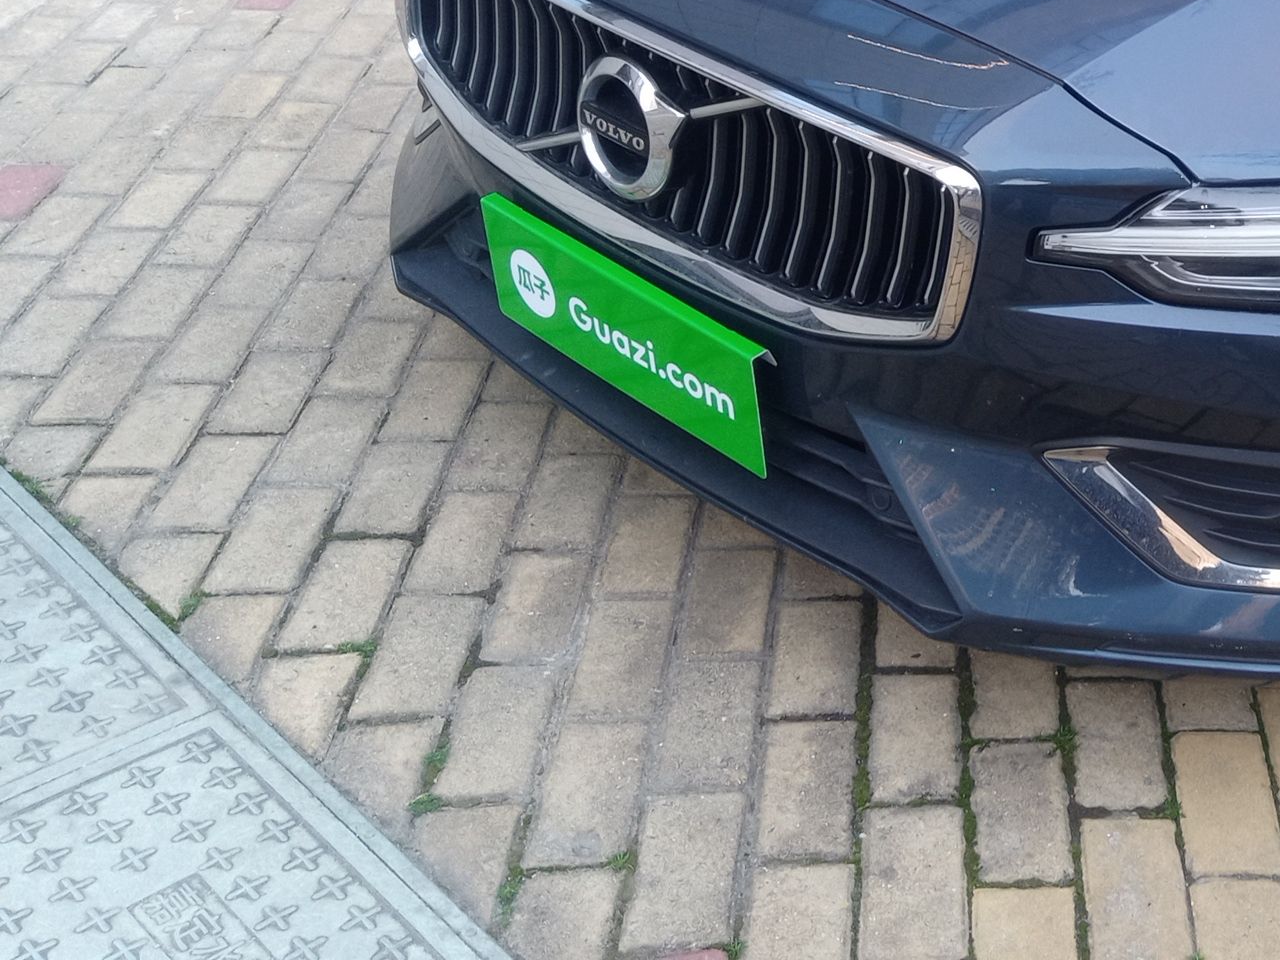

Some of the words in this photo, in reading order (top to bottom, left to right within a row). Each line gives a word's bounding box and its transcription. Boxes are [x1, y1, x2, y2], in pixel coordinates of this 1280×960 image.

[582, 108, 645, 151] VOLVO
[517, 264, 550, 301] 瓜子
[568, 296, 735, 421] Guazi.com
